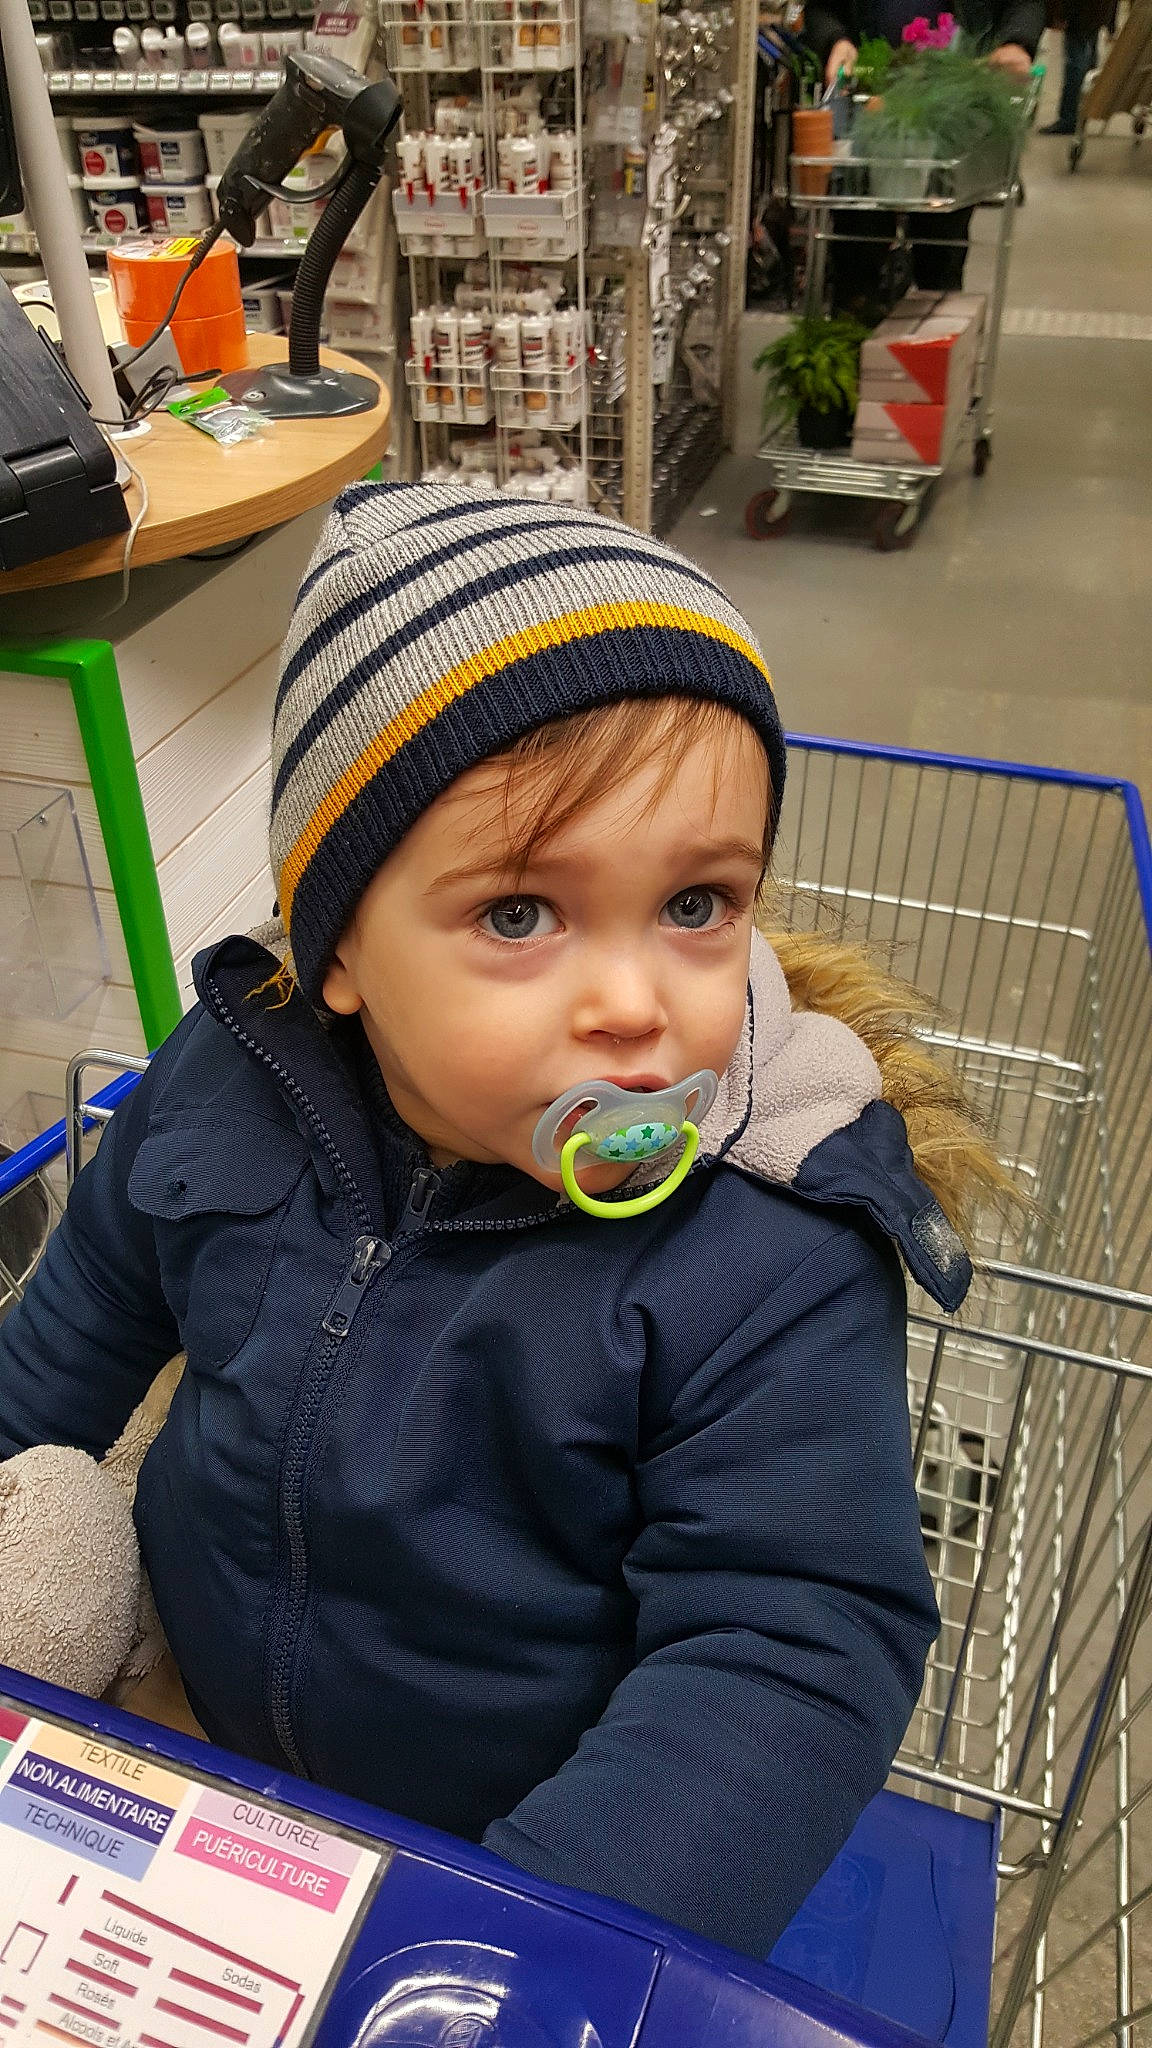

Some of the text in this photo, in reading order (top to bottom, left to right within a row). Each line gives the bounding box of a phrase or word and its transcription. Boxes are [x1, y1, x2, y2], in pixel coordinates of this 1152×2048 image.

[78, 1742, 148, 1781] TEXTILE
[16, 1758, 171, 1834] NON ALIMENTAIRE
[24, 1803, 125, 1859] TECHNIQUE
[233, 1804, 321, 1851] CULTUREL
[192, 1829, 331, 1897] PUÉRICULTURE
[104, 1917, 148, 1946] Liquide
[92, 1952, 120, 1974] Soft
[222, 1967, 262, 1994] Sodas
[76, 1982, 117, 2010] Rosés
